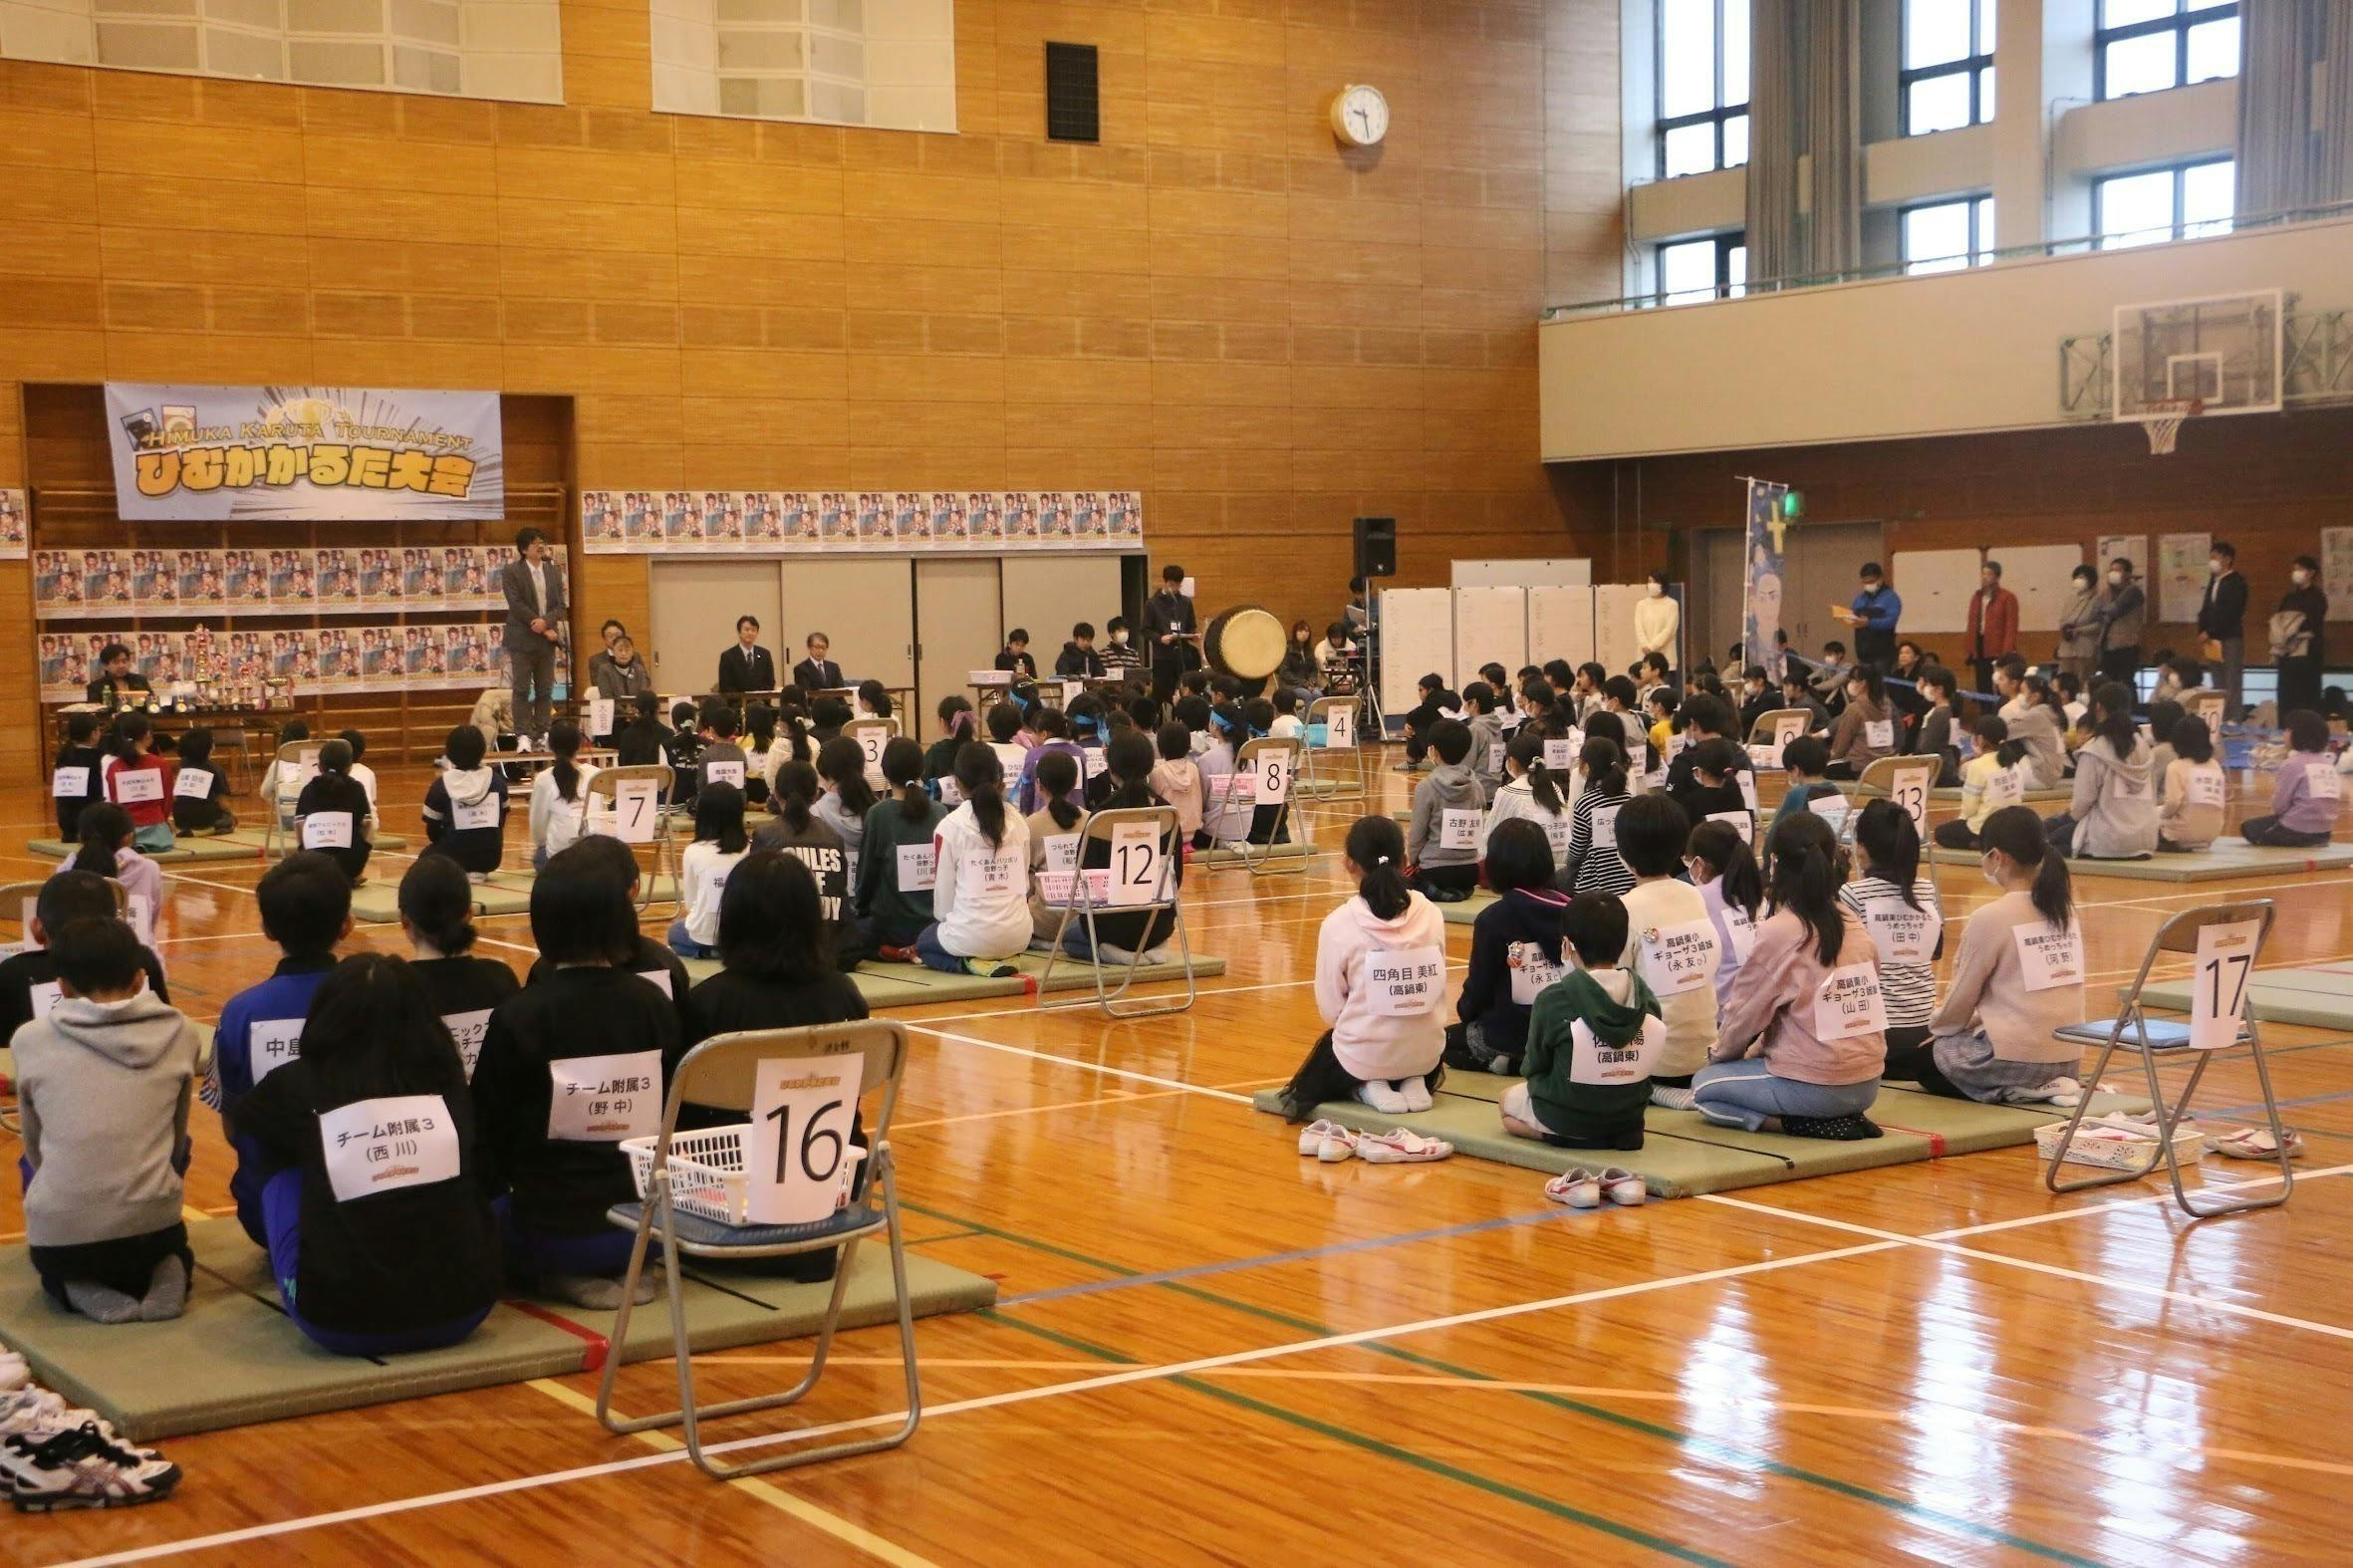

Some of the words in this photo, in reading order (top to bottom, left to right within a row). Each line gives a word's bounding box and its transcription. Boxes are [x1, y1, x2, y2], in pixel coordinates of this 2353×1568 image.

[150, 425, 233, 446] HIMUKA
[240, 421, 324, 441] KARUTA
[335, 422, 474, 450] TOURNAMENT
[135, 443, 476, 498] ひむかかるた大会
[1335, 717, 1346, 737] 4
[867, 739, 878, 763] 3
[1267, 763, 1280, 791] 8
[629, 797, 646, 828] 7
[1897, 787, 1923, 822] 13
[1051, 842, 1079, 851] つられて
[1117, 844, 1154, 886] 12
[1892, 931, 1921, 943] (田中)
[1654, 939, 1714, 961] ギョーザ3姉妹
[1373, 967, 1413, 981] 四角目
[1418, 963, 1438, 979] 美紅
[1389, 981, 1428, 996] (高鍋東)
[2206, 954, 2251, 1018] 17
[1842, 998, 1870, 1015] (山田)
[1597, 1050, 1640, 1064] (高鍋東)
[566, 1077, 651, 1096] チーム附属3
[588, 1098, 634, 1116] (野中)
[337, 1117, 435, 1148] チーム附属3
[765, 1100, 843, 1184] 16
[366, 1139, 418, 1164] (西川)
